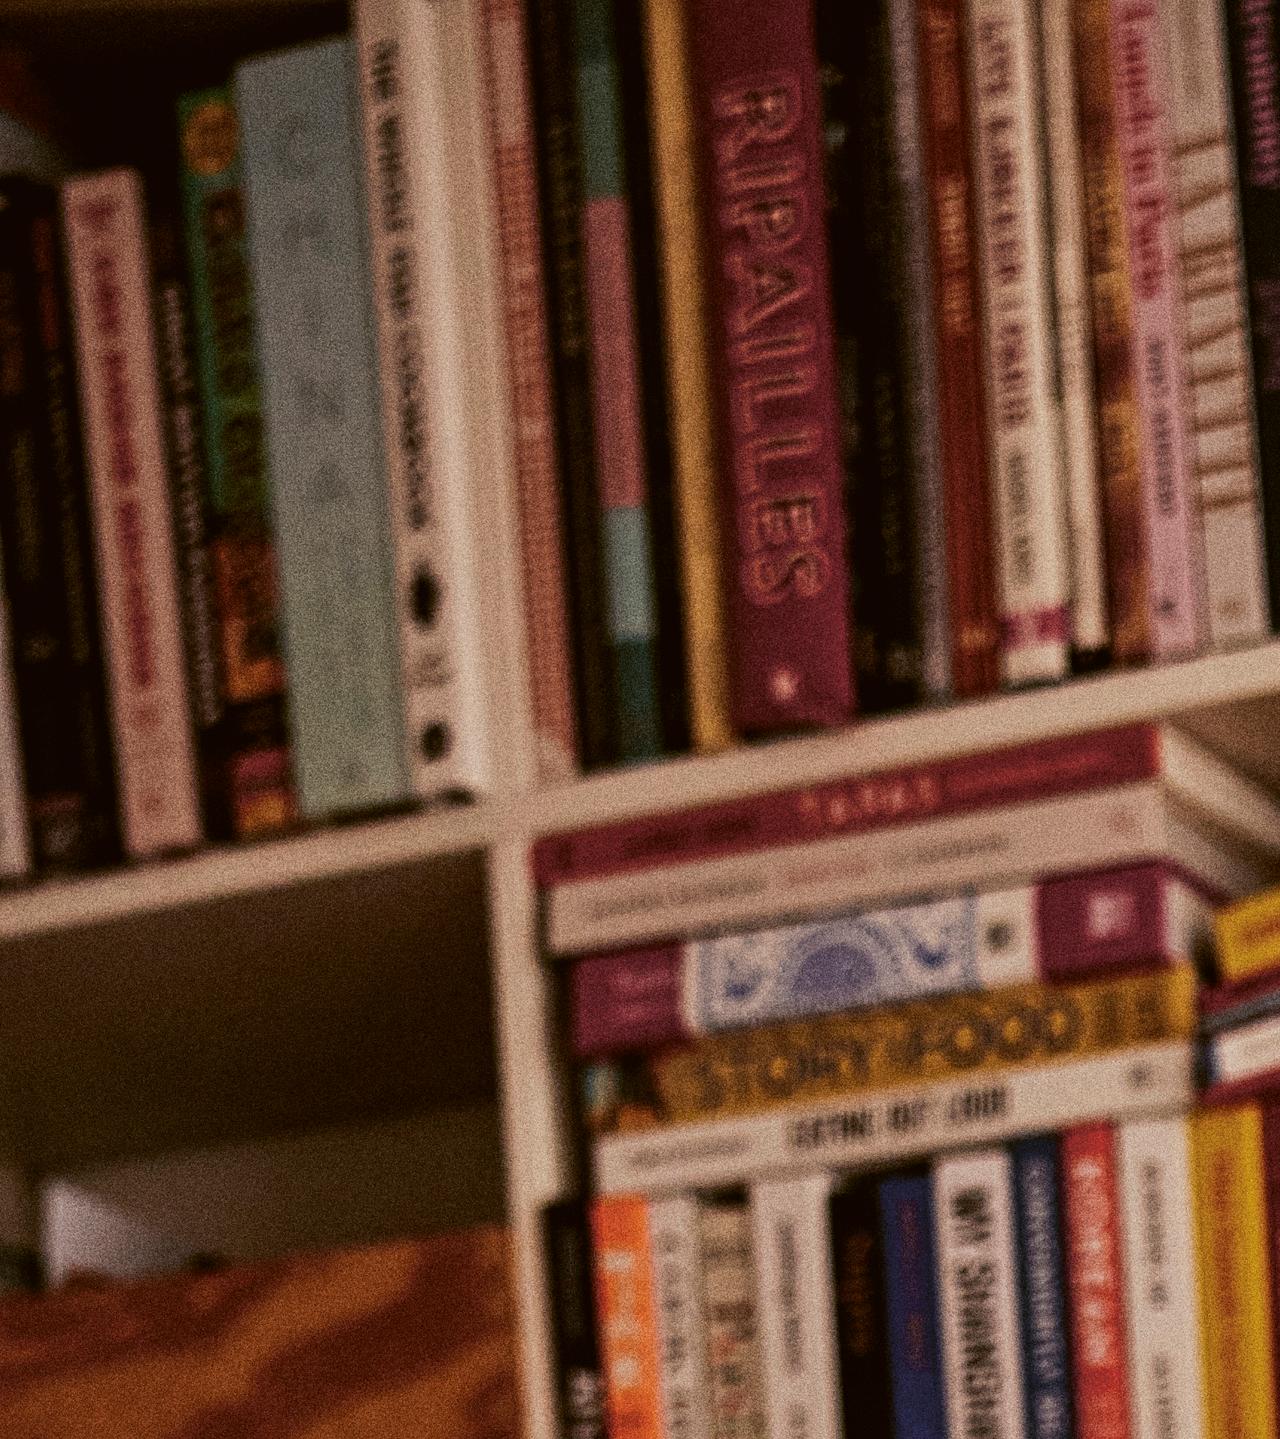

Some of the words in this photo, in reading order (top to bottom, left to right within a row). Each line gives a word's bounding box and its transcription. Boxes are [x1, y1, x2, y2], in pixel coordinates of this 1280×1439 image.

[712, 72, 832, 606] RIPAILLES
[1127, 199, 1170, 299] Paris
[1066, 1156, 1119, 1367] KOREAN
